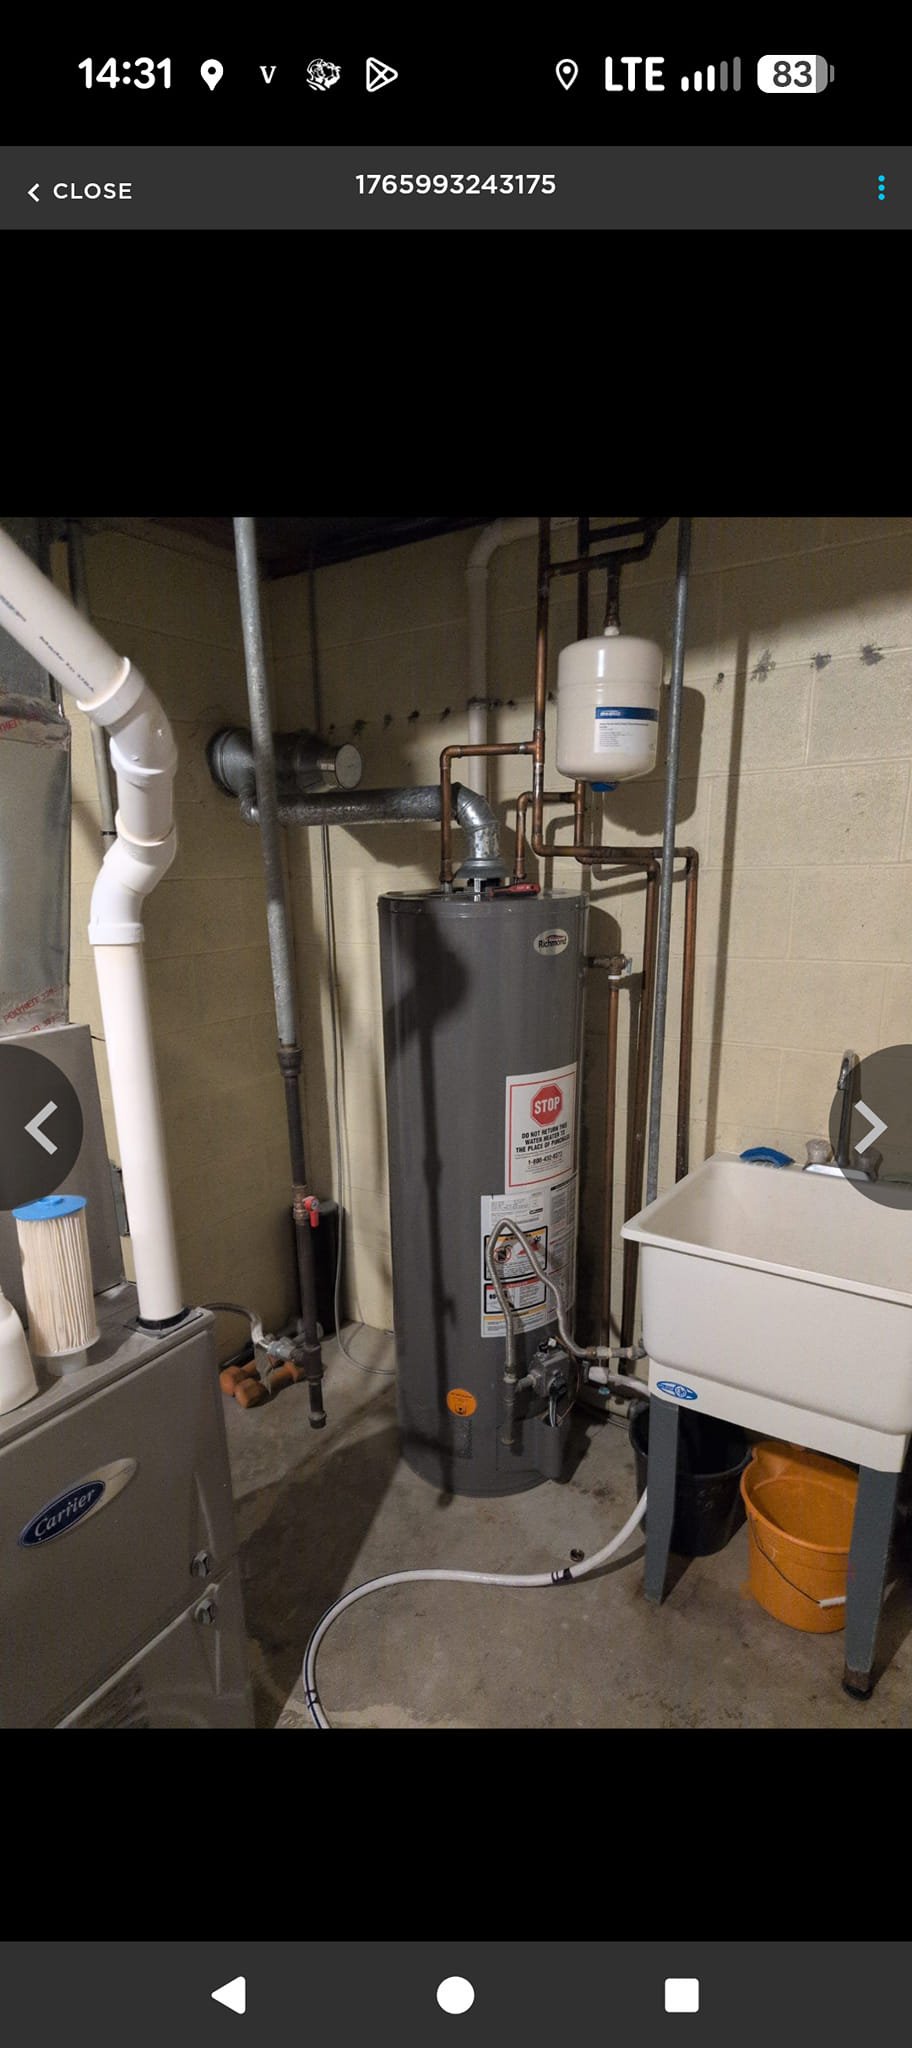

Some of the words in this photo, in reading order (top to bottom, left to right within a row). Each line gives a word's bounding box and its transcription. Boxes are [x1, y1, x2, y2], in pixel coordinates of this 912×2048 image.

[538, 935, 567, 949] Richmond
[534, 1096, 560, 1114] STOP
[525, 1137, 542, 1145] WATER
[527, 1143, 543, 1151] PLACE
[35, 1489, 96, 1537] Carrier
